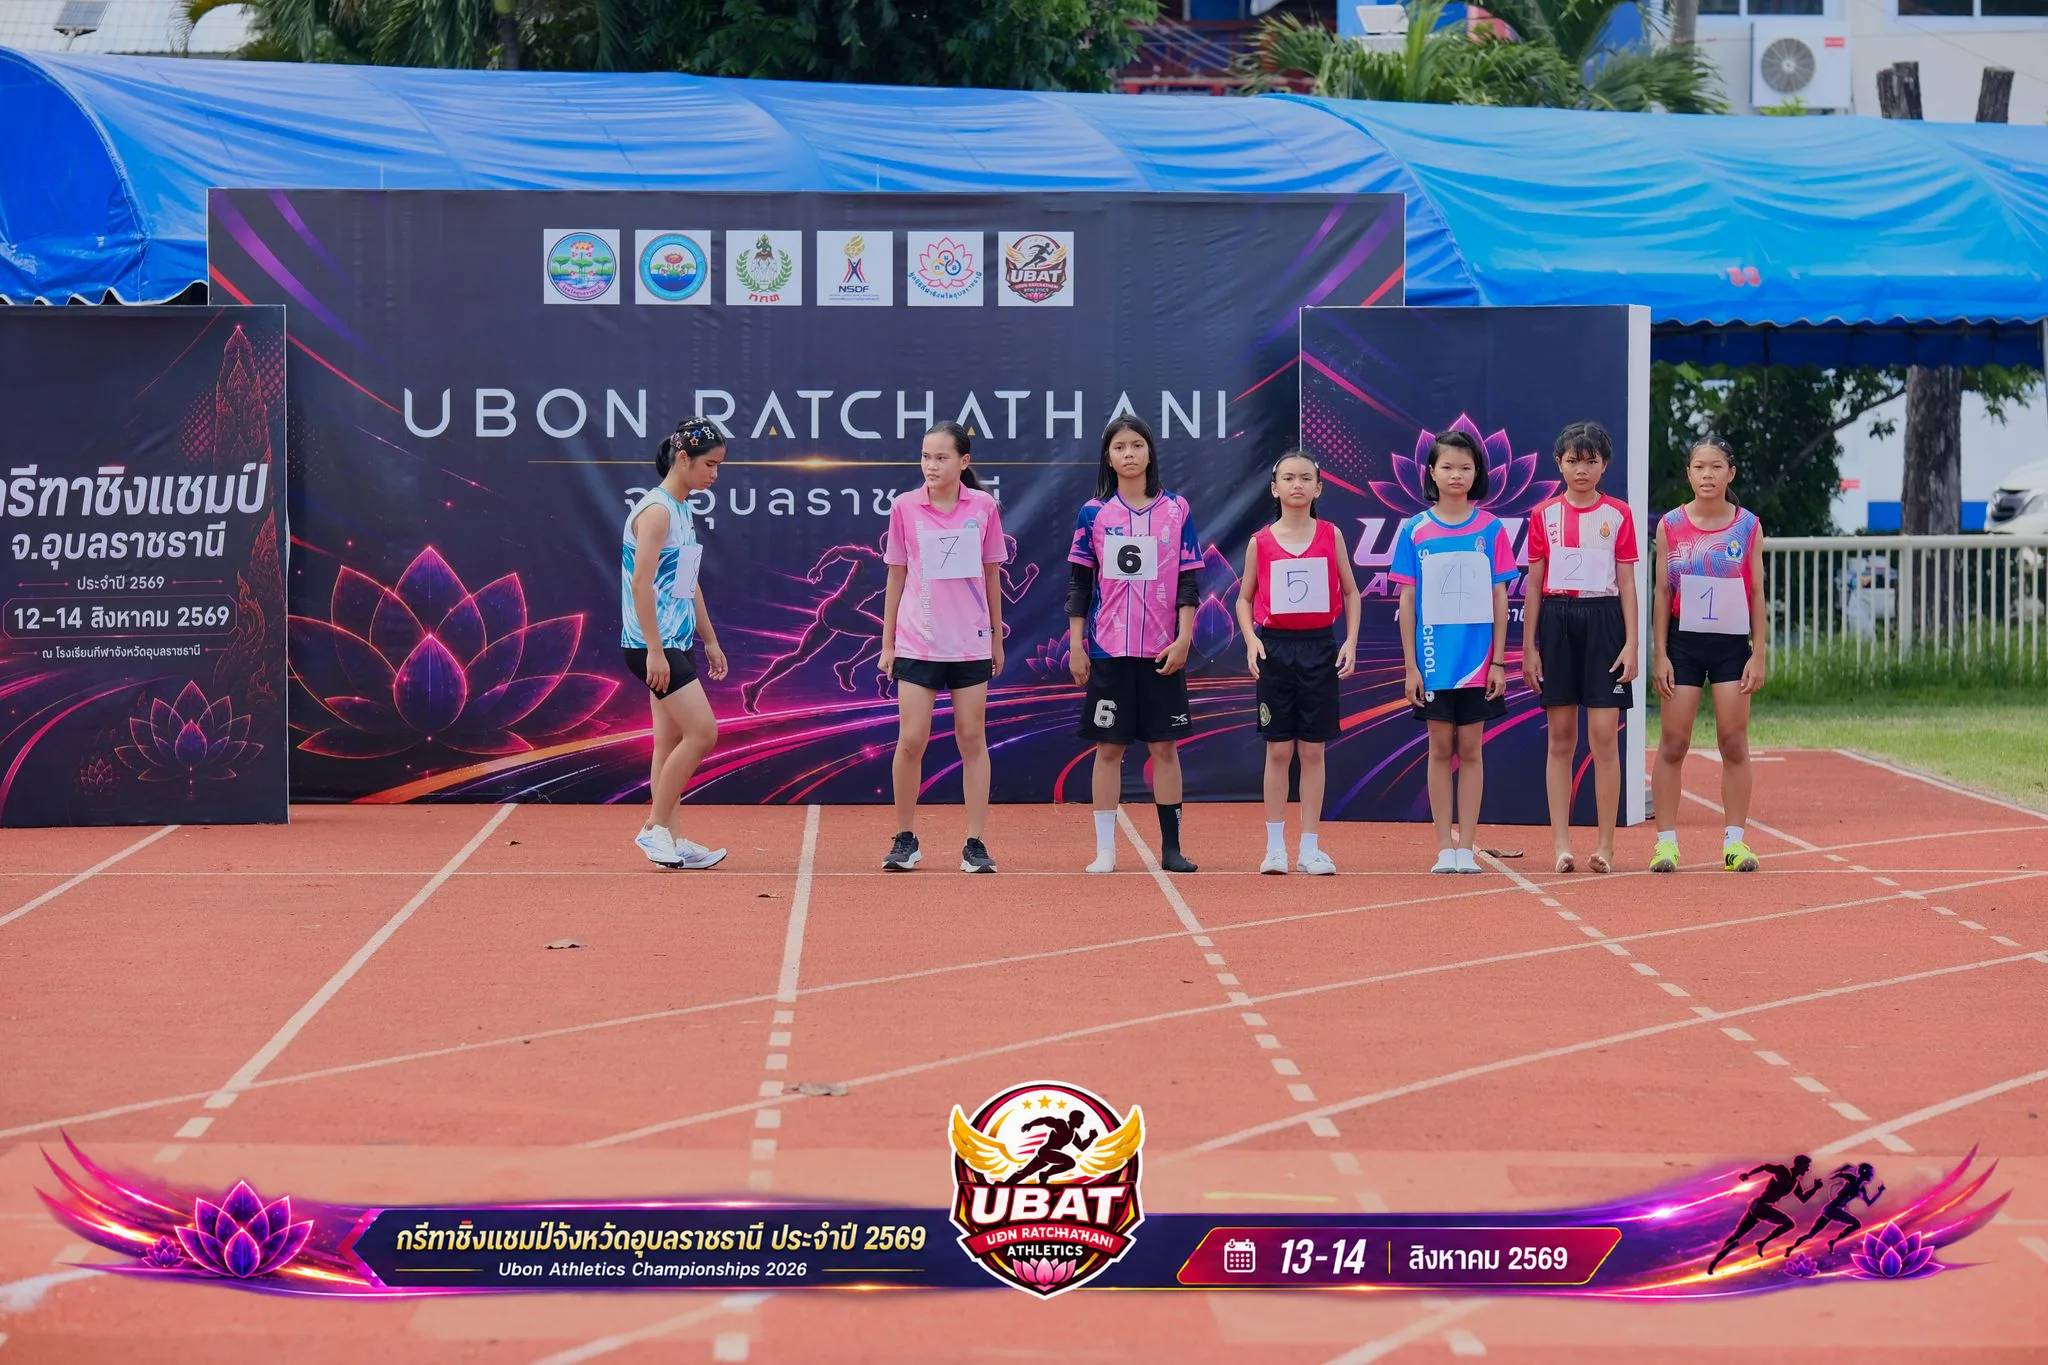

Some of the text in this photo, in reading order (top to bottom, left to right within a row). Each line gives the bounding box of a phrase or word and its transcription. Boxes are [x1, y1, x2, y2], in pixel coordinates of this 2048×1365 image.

[838, 285, 870, 293] NSDF
[1011, 270, 1062, 283] UBAT
[404, 388, 1226, 440] UBON RATCHATHANI
[0, 462, 269, 518] รีฑาชิงแชมป์
[12, 520, 227, 571] จ.อุบลราชธานี
[939, 536, 960, 569] 7
[1117, 544, 1142, 574] 6
[1564, 553, 1585, 581] 2
[77, 575, 165, 591] ประจำปี 2569
[1286, 570, 1309, 604] 5
[1441, 563, 1470, 615] 4
[90, 606, 169, 629] สิงหาคม
[177, 605, 230, 627] 2569
[1700, 586, 1719, 621] 1
[42, 649, 53, 659] ณ
[1423, 624, 1436, 678] CHOOL
[1093, 699, 1118, 729] 6
